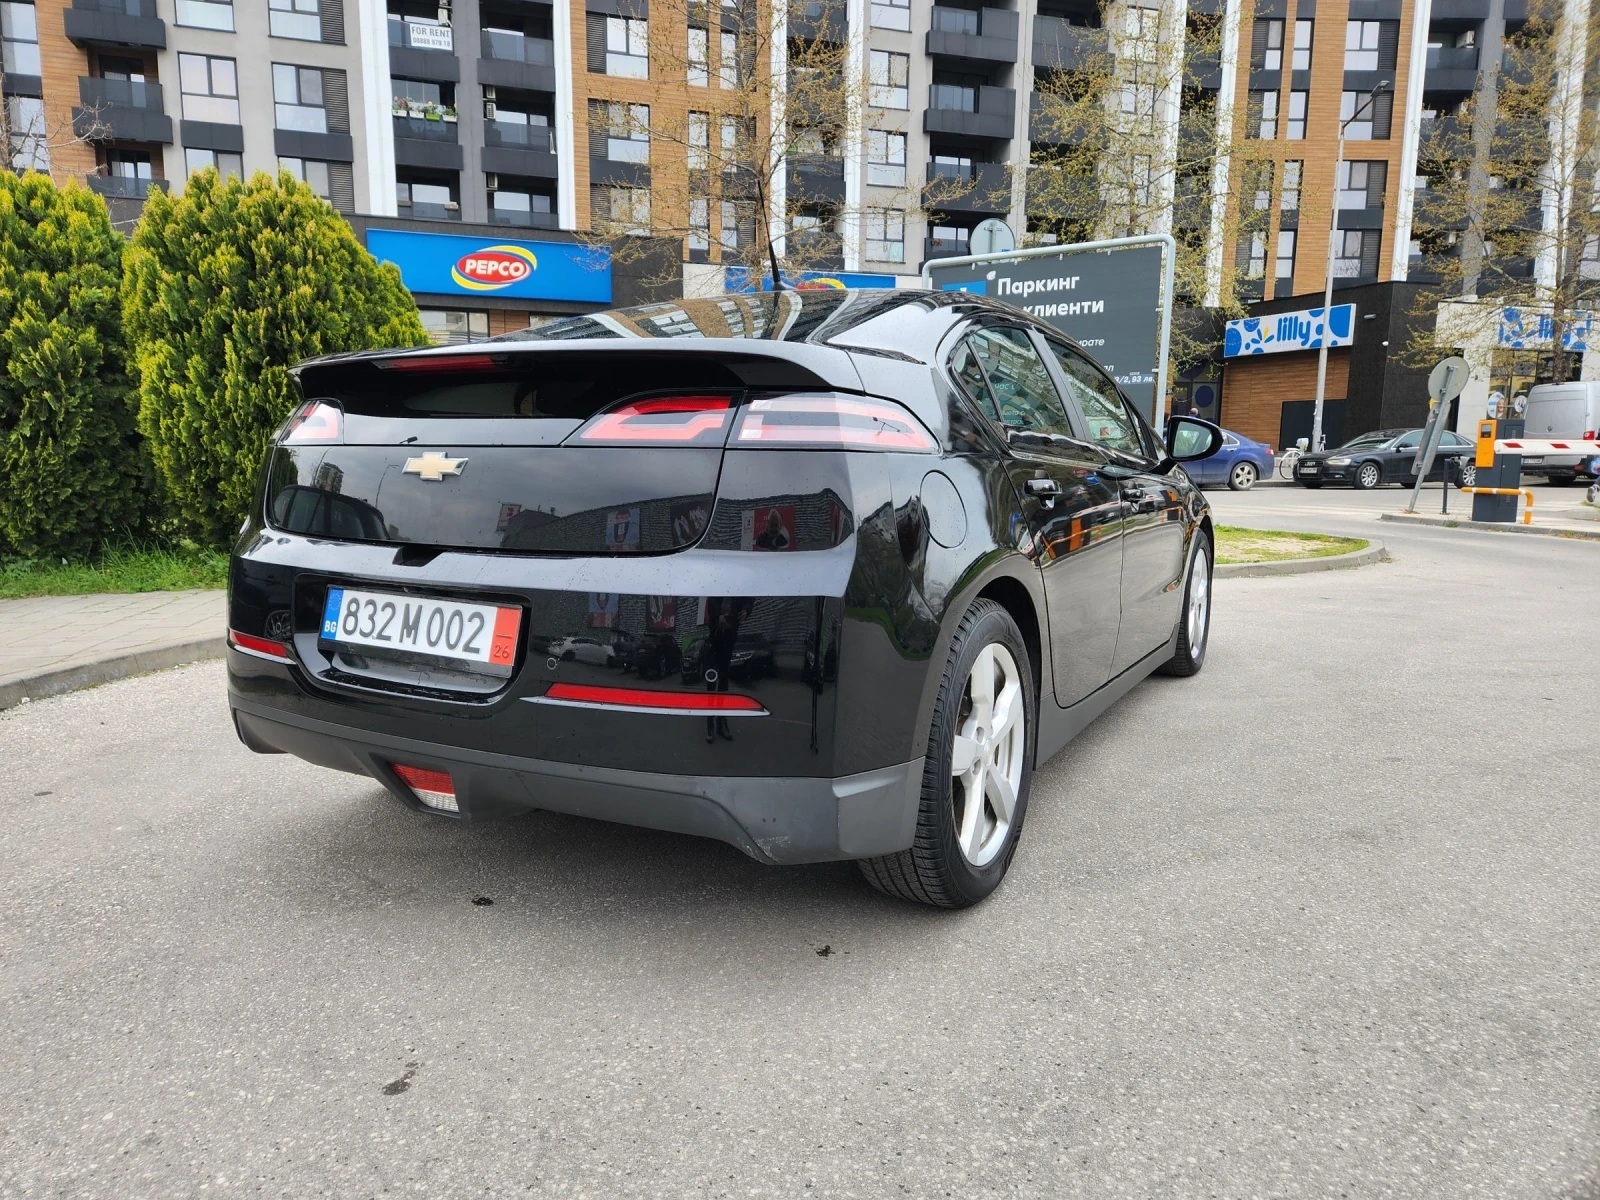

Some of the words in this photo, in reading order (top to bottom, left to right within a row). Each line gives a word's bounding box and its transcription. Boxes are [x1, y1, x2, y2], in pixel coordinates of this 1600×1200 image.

[412, 26, 427, 36] FOR
[430, 28, 450, 38] RENT
[464, 258, 525, 277] PEPCO
[997, 276, 1080, 298] Паркинг
[1276, 315, 1311, 347] lilly
[323, 620, 337, 633] BG
[493, 644, 510, 659] 26
